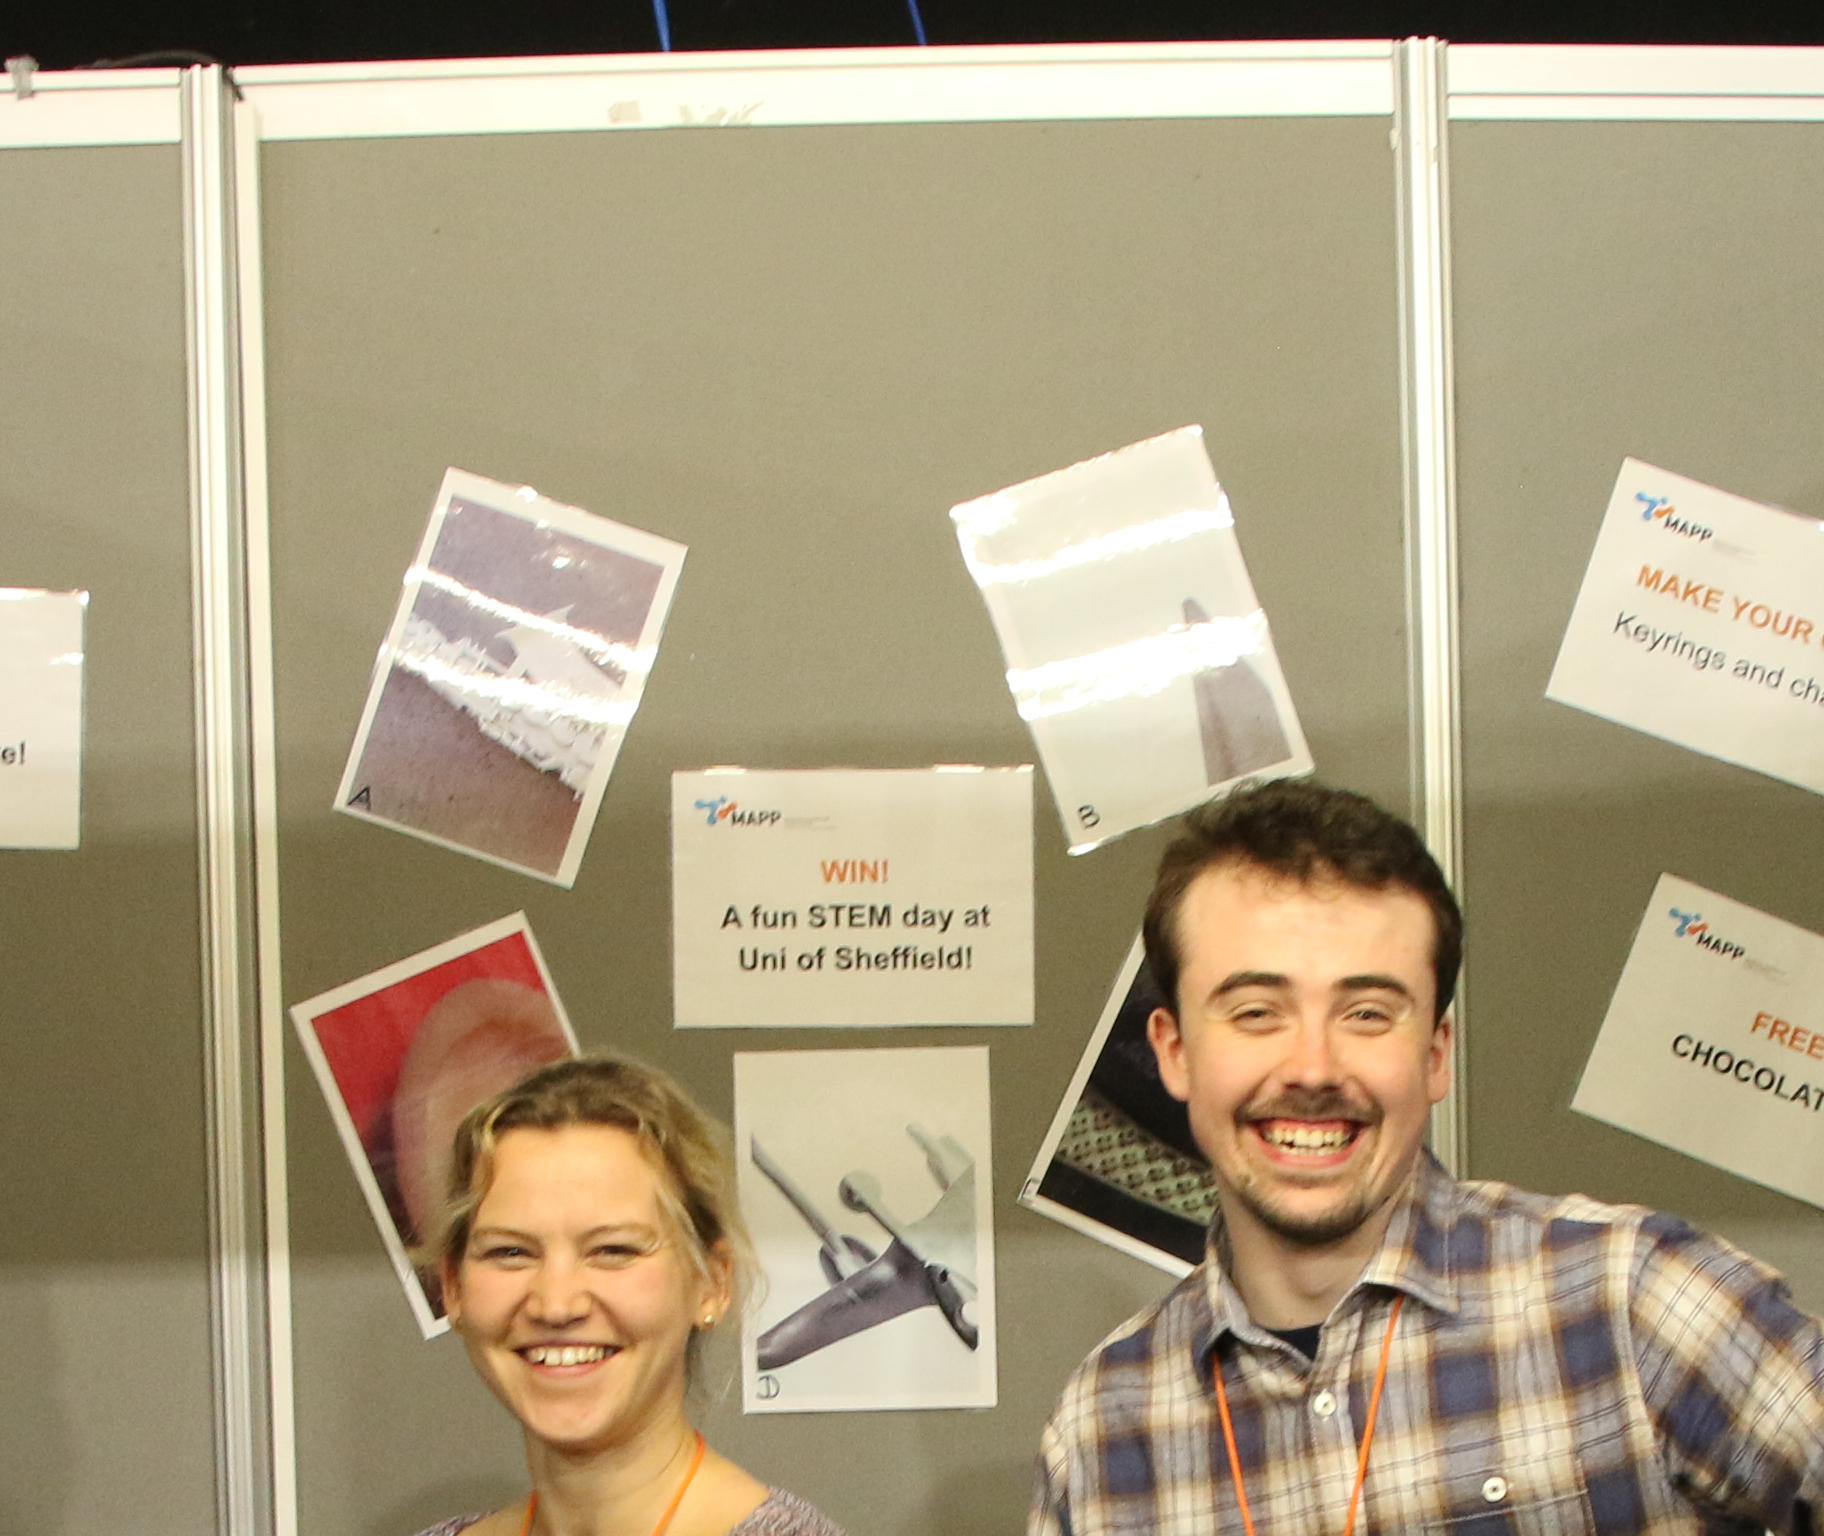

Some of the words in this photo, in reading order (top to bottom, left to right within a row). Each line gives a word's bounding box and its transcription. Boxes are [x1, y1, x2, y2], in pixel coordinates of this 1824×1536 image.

[1664, 517, 1713, 542] MAPP
[1637, 565, 1724, 613] MAKE
[1733, 597, 1814, 643] YOUR
[1614, 611, 1726, 670] Keyrings
[1734, 656, 1786, 688] and
[347, 785, 372, 810] A
[731, 811, 781, 826] MAPP
[1077, 804, 1101, 830] B
[821, 860, 889, 883] WIN!
[721, 906, 742, 928] A
[751, 904, 797, 928] fun
[809, 905, 891, 928] STEM
[903, 904, 954, 933] day
[964, 906, 991, 927] at
[740, 947, 786, 970] Uni
[797, 947, 827, 970] of
[835, 946, 972, 970] Sheffield!
[1697, 933, 1745, 960] MAPP
